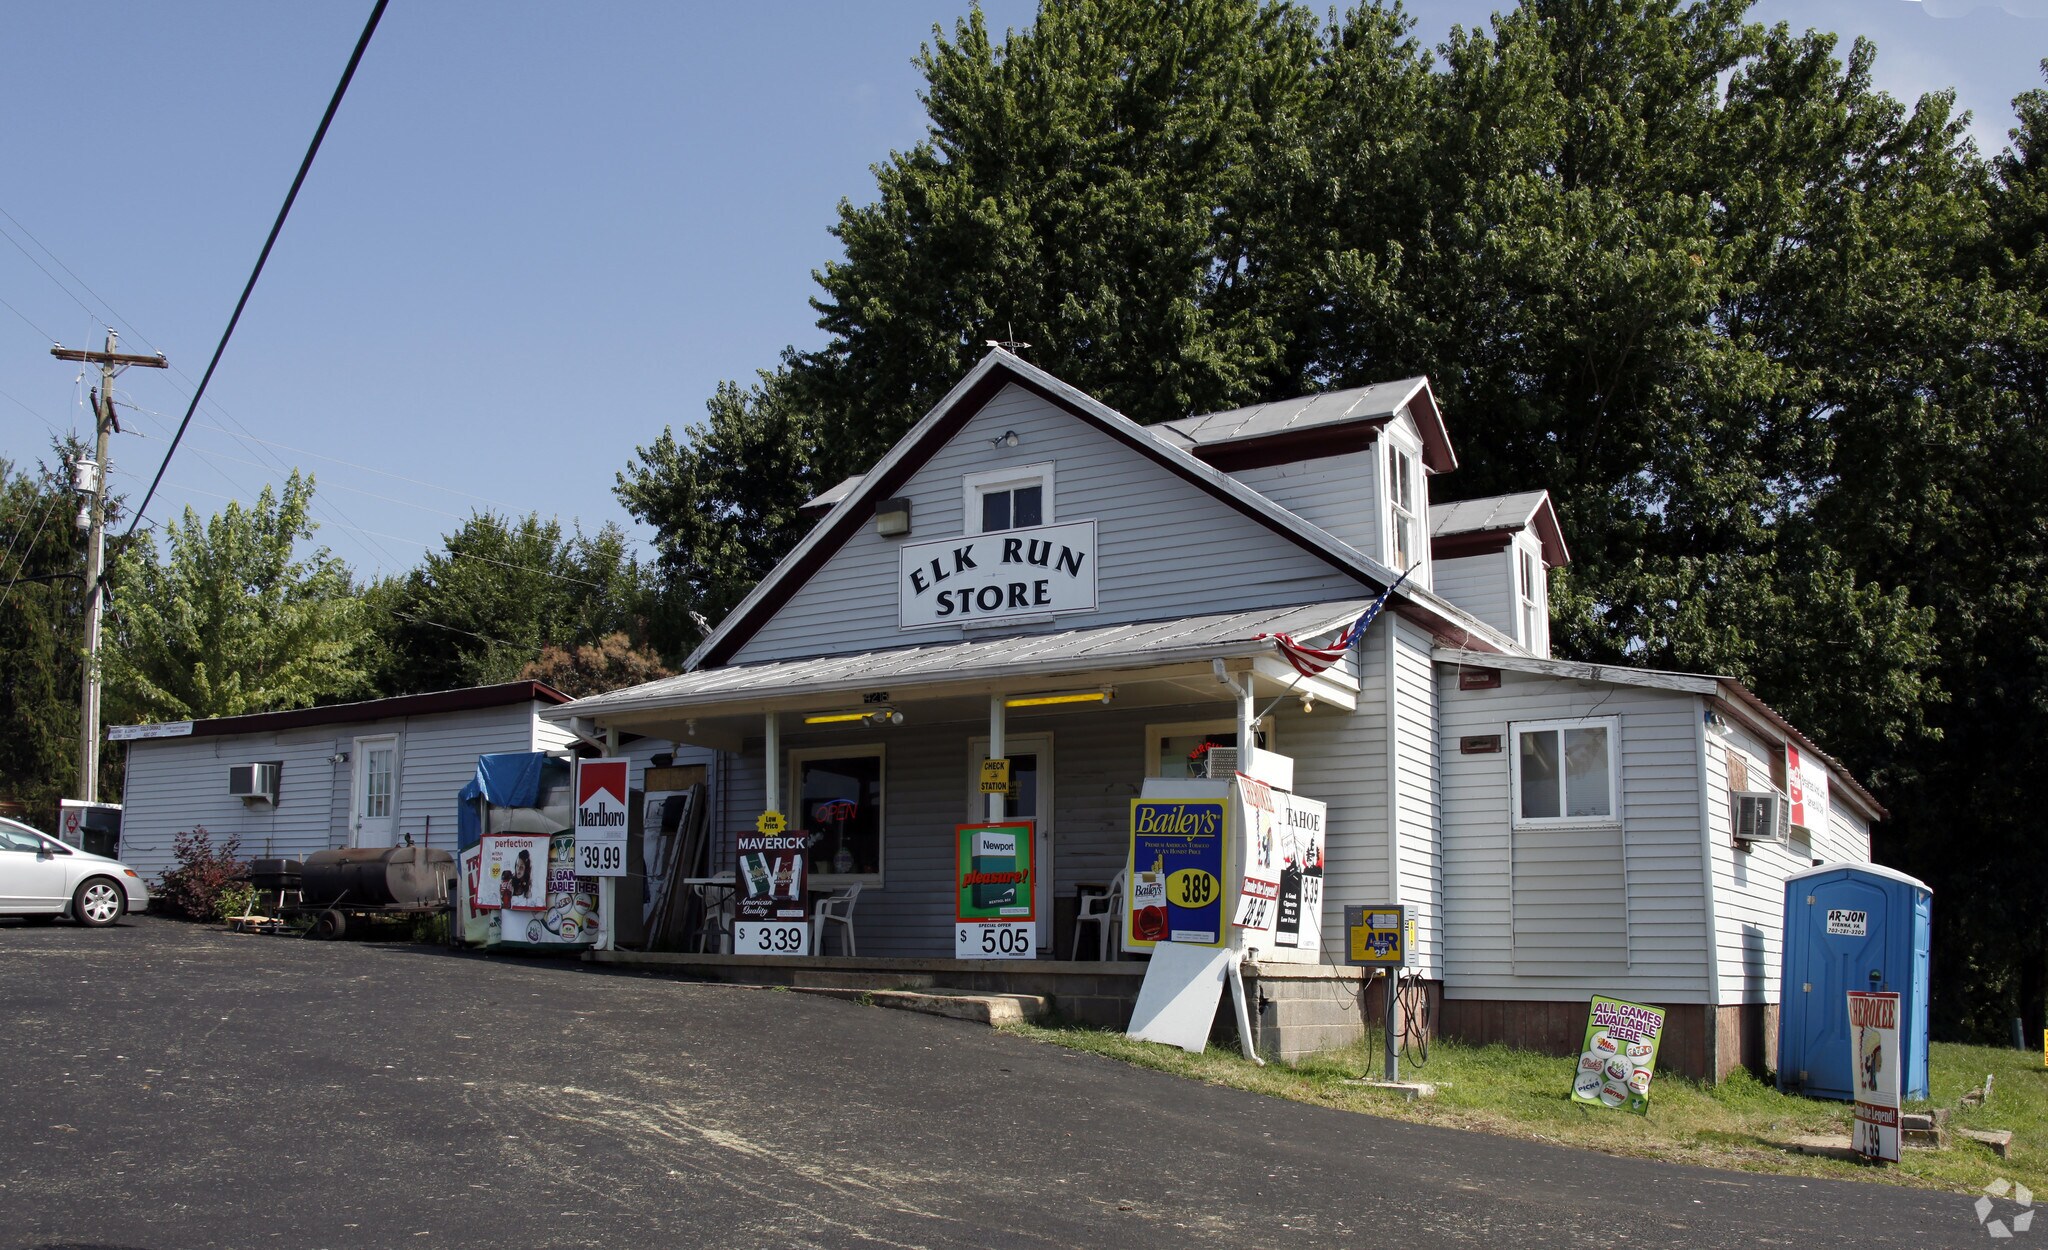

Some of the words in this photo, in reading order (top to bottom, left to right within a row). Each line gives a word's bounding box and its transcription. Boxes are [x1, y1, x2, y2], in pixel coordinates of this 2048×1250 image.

[909, 544, 978, 596] ELK
[1002, 537, 1085, 578] RUN
[935, 579, 1052, 615] STORE
[984, 761, 1005, 770] CHECK
[981, 782, 1007, 790] STATION
[578, 802, 625, 827] Marlboro
[816, 802, 858, 823] OPEN
[1286, 808, 1320, 831] TAHOE
[1136, 805, 1217, 842] Bailey's
[495, 839, 533, 849] perfection
[738, 837, 806, 849] MAVERICK
[983, 840, 1014, 851] Newport
[962, 869, 1029, 888] pleasure!
[1182, 873, 1210, 903] 3.89
[737, 897, 772, 906] American
[742, 906, 768, 917] Quality
[1829, 910, 1865, 922] AR-JON
[739, 928, 745, 939] $
[759, 927, 802, 951] 3.39
[960, 929, 967, 943] $
[982, 928, 1029, 955] 5.05
[1364, 932, 1399, 951] AIR
[1594, 1003, 1616, 1015] ALL
[1619, 1005, 1662, 1027] GAMES
[1849, 998, 1895, 1030] CHEROKEE
[1594, 1014, 1657, 1036] AVAILABLE
[1608, 1026, 1641, 1042] HERE
[1578, 1081, 1600, 1092] PICK4
[1872, 1107, 1896, 1123] Legend!
